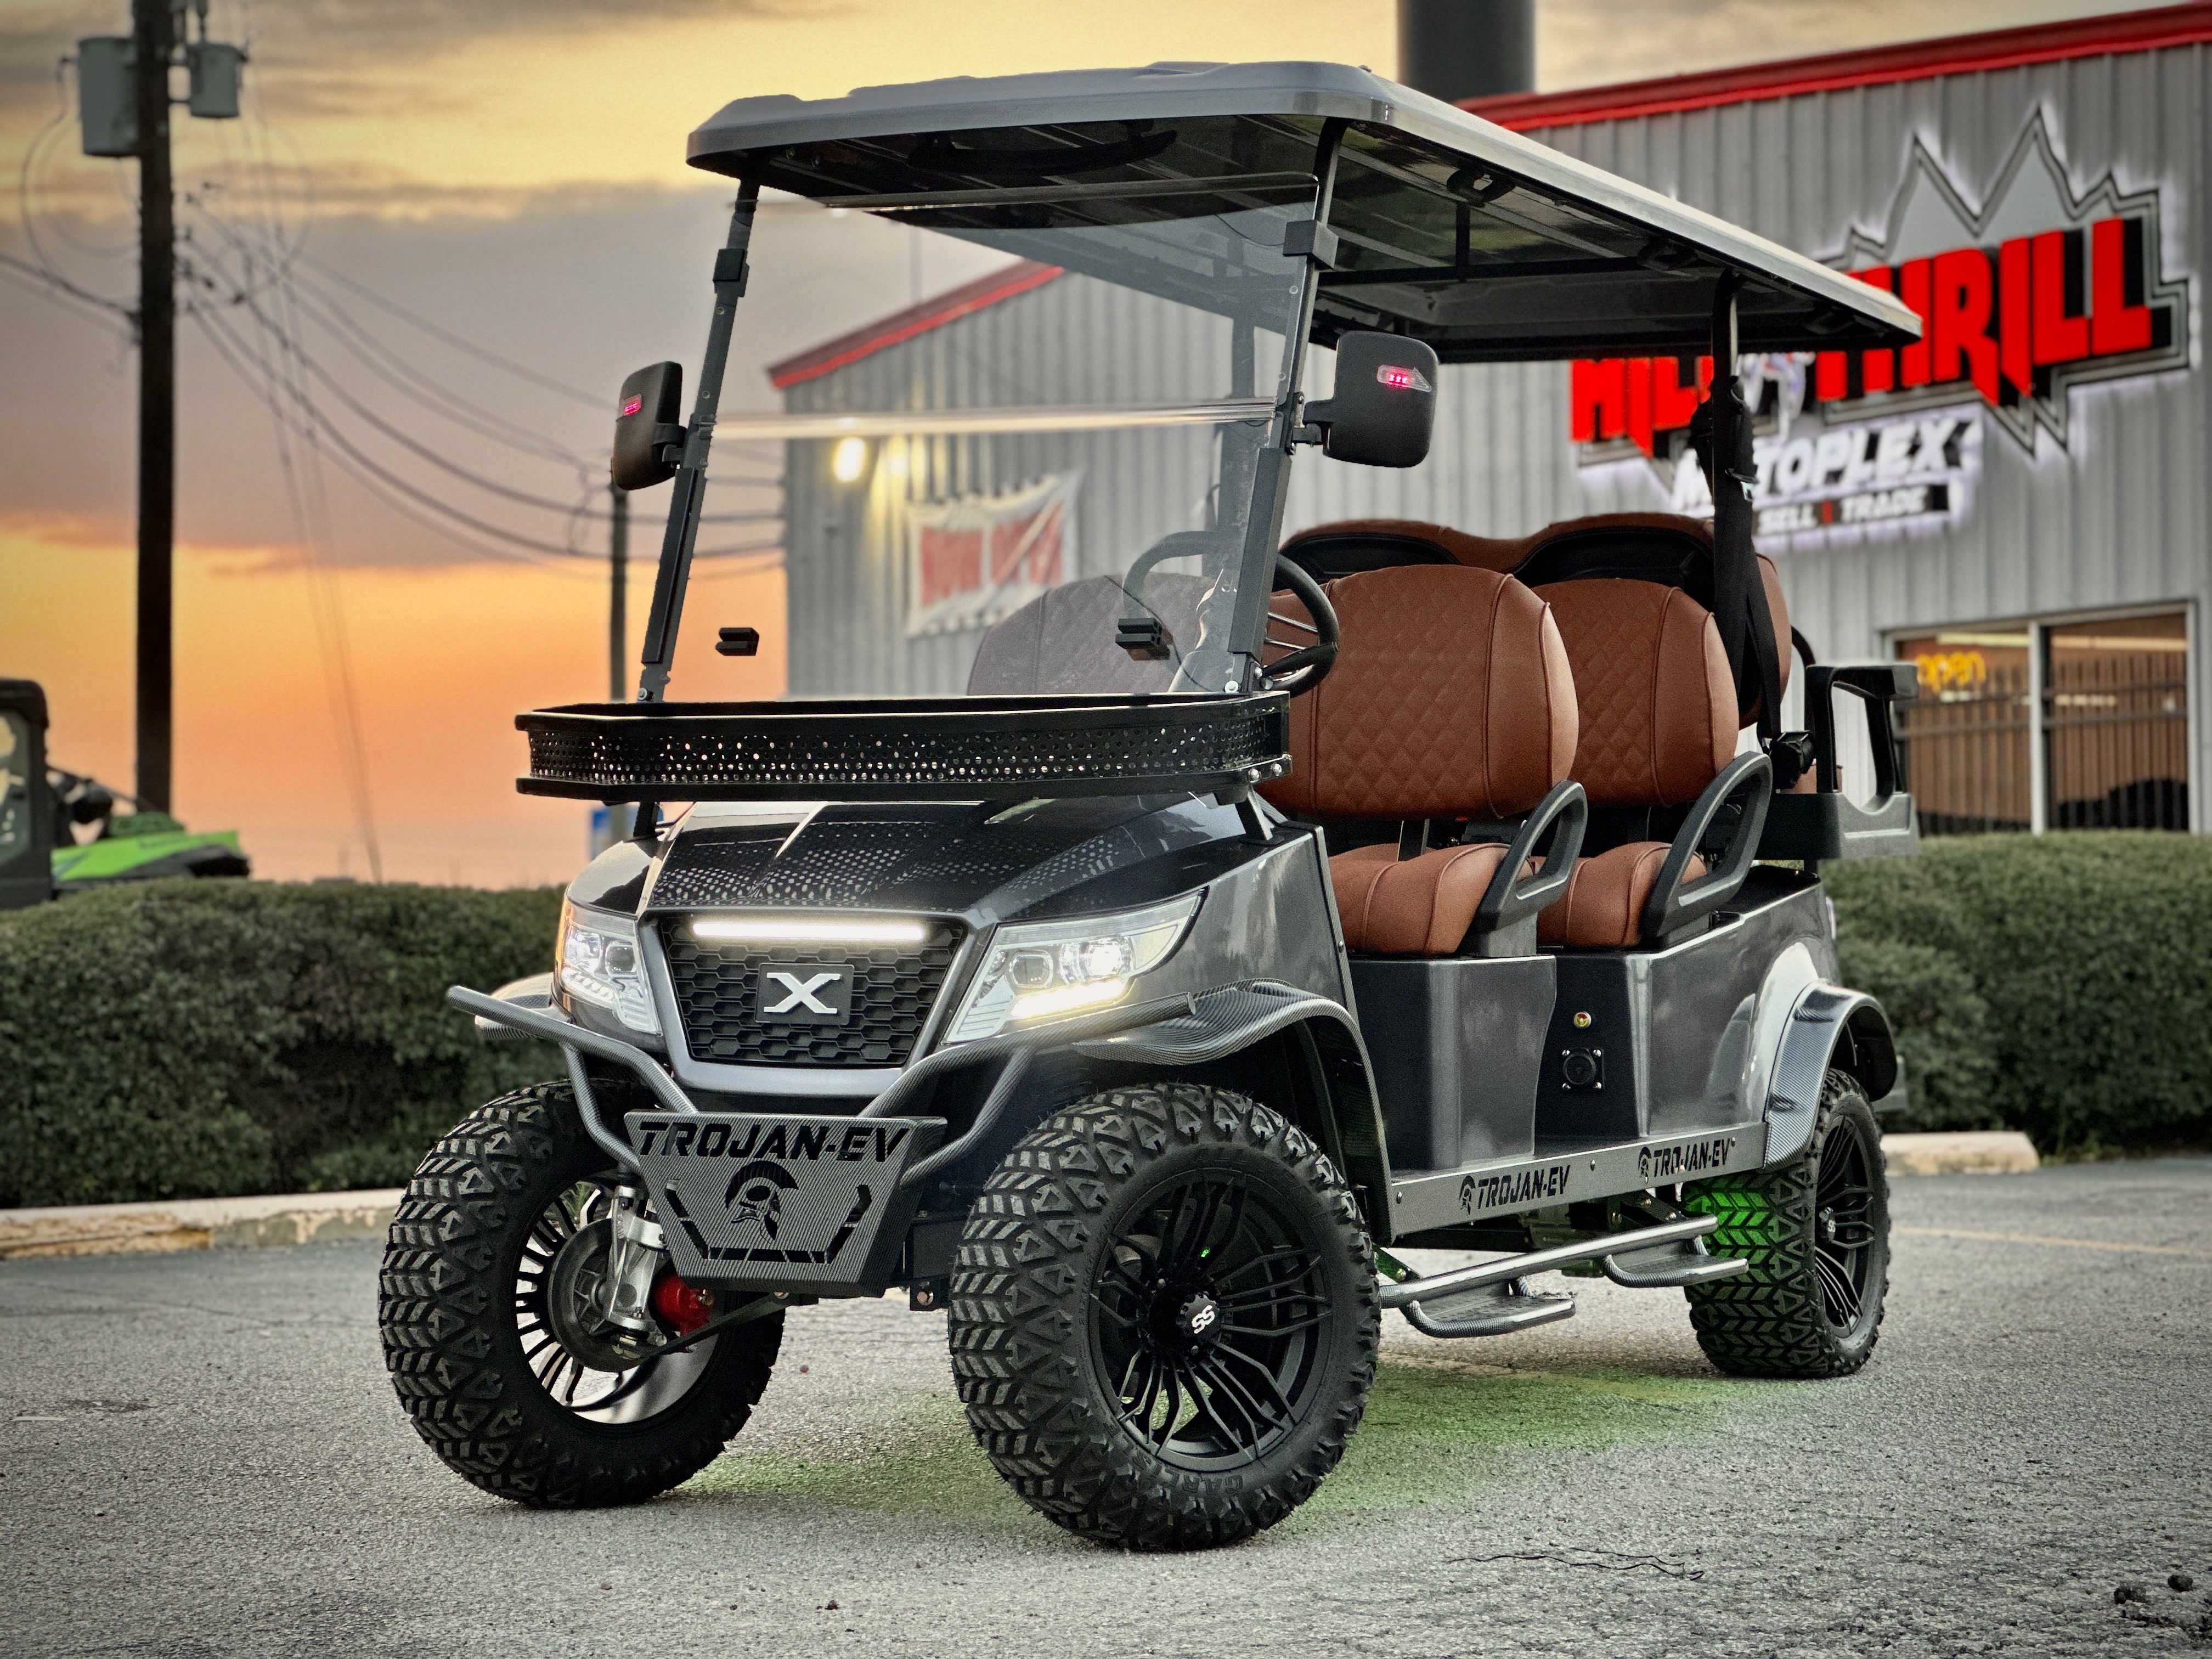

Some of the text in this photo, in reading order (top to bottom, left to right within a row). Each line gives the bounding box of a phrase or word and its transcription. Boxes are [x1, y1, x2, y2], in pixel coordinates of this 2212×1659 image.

[1673, 419, 1959, 509] MTOPLEX
[1842, 487, 1927, 522] TRADE
[639, 1121, 910, 1163] TROJAN-EV
[1652, 1139, 1730, 1178] TROJAN-EV
[1476, 1166, 1570, 1209] TROJAN-EV
